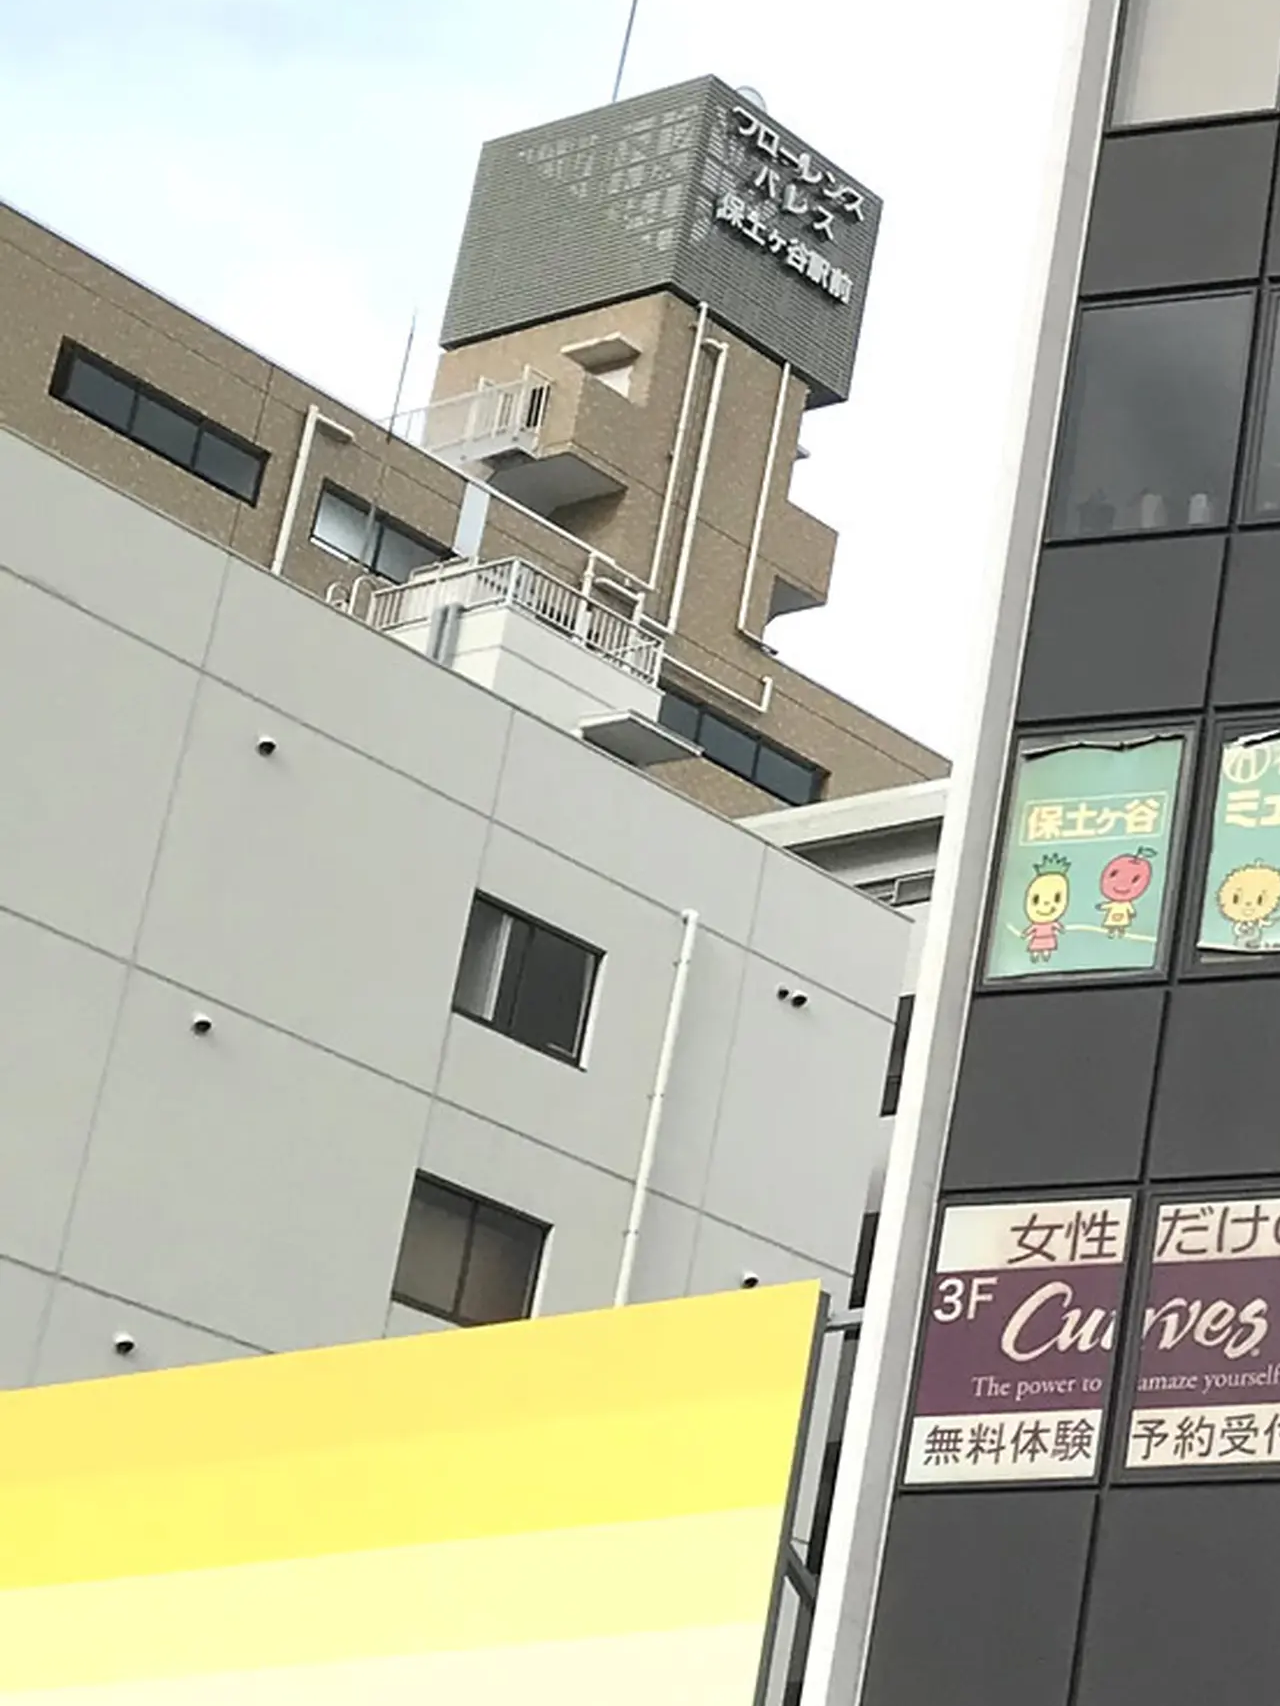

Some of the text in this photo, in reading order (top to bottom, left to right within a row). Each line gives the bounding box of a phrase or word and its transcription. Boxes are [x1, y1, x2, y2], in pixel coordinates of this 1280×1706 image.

[932, 1275, 999, 1323] 3F
[970, 1375, 1011, 1397] The
[1015, 1375, 1077, 1401] power
[1081, 1377, 1103, 1393] to
[1136, 1373, 1198, 1392] amaze
